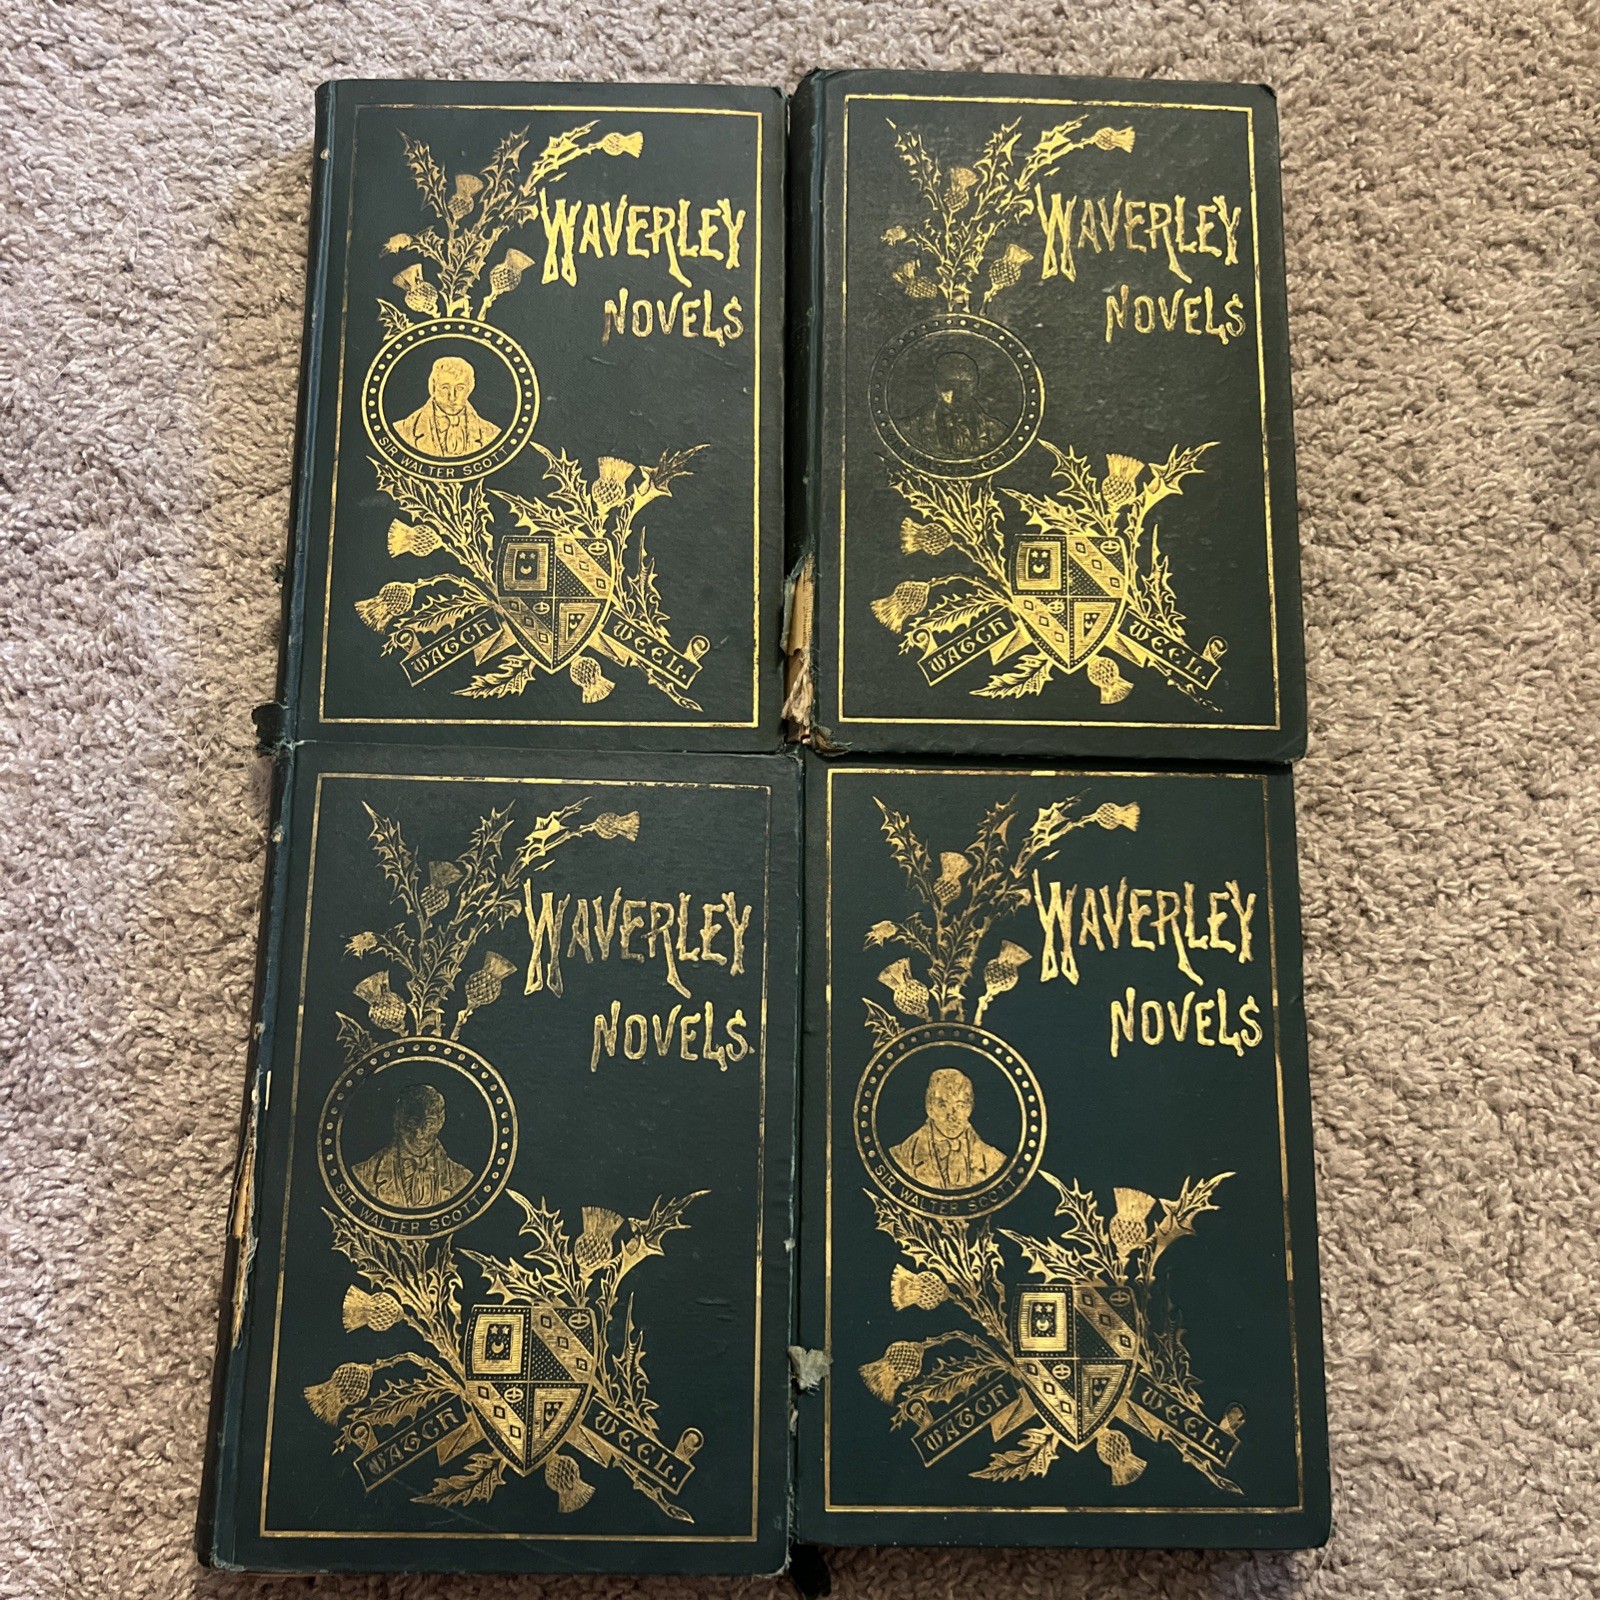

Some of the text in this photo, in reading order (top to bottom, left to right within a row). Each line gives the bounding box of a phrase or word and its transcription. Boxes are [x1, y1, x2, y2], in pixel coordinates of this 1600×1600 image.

[539, 187, 746, 288] WAVERLEY
[1034, 182, 1241, 284] WAVERLEY
[602, 287, 744, 347] NOVELS
[1105, 284, 1246, 345] NOVELS
[378, 437, 509, 478] SIR WALTER SCOTT
[523, 878, 752, 999] WAVERLEY
[1031, 868, 1257, 986] WAVERLEY
[591, 1000, 749, 1072] NOVELS
[1110, 987, 1263, 1057] NOVELS
[335, 1183, 482, 1234] SIR WALTER SCOTT
[874, 1163, 1016, 1215] SIR WALTER SCOTT
